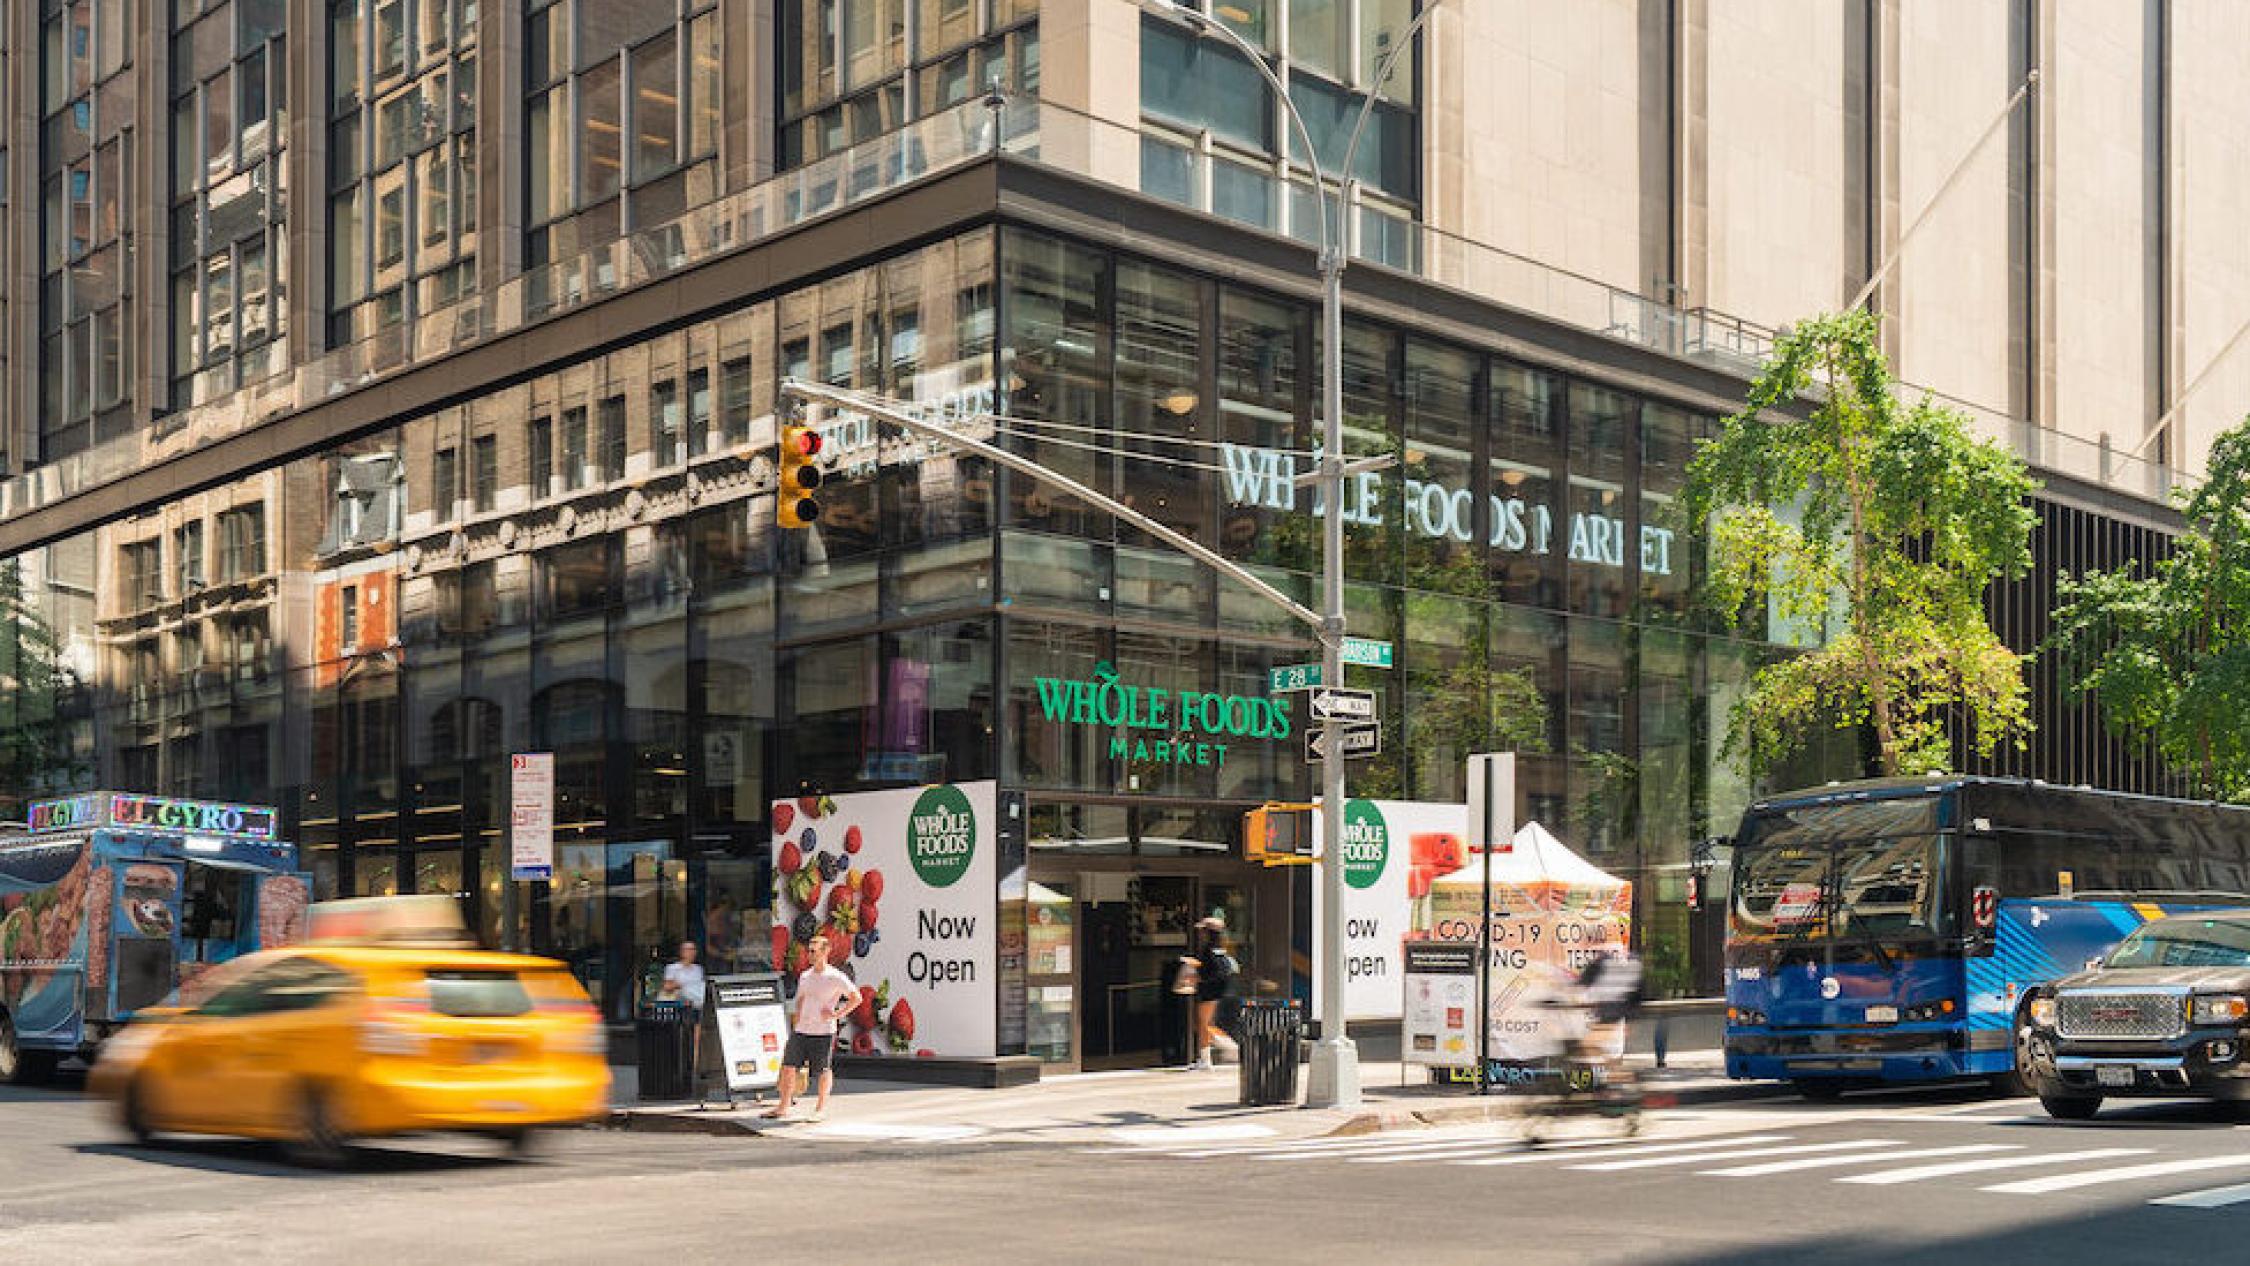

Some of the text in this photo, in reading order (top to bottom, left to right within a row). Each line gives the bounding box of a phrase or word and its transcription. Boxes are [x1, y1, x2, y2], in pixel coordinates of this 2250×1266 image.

[1221, 443, 1384, 525] WHLE
[1275, 668, 1283, 688] E
[1034, 672, 1291, 740] WHOLE FOODS
[1109, 736, 1228, 768] MARKET
[115, 799, 243, 831] EL GYRO
[913, 811, 969, 837] WHOLE
[916, 834, 969, 856] FOODS
[917, 908, 976, 940] Now
[1347, 918, 1378, 939] ow
[1438, 919, 1542, 944] COVD-19
[907, 951, 976, 990] Open
[1344, 955, 1386, 983] pen
[1504, 1021, 1541, 1034] COST
